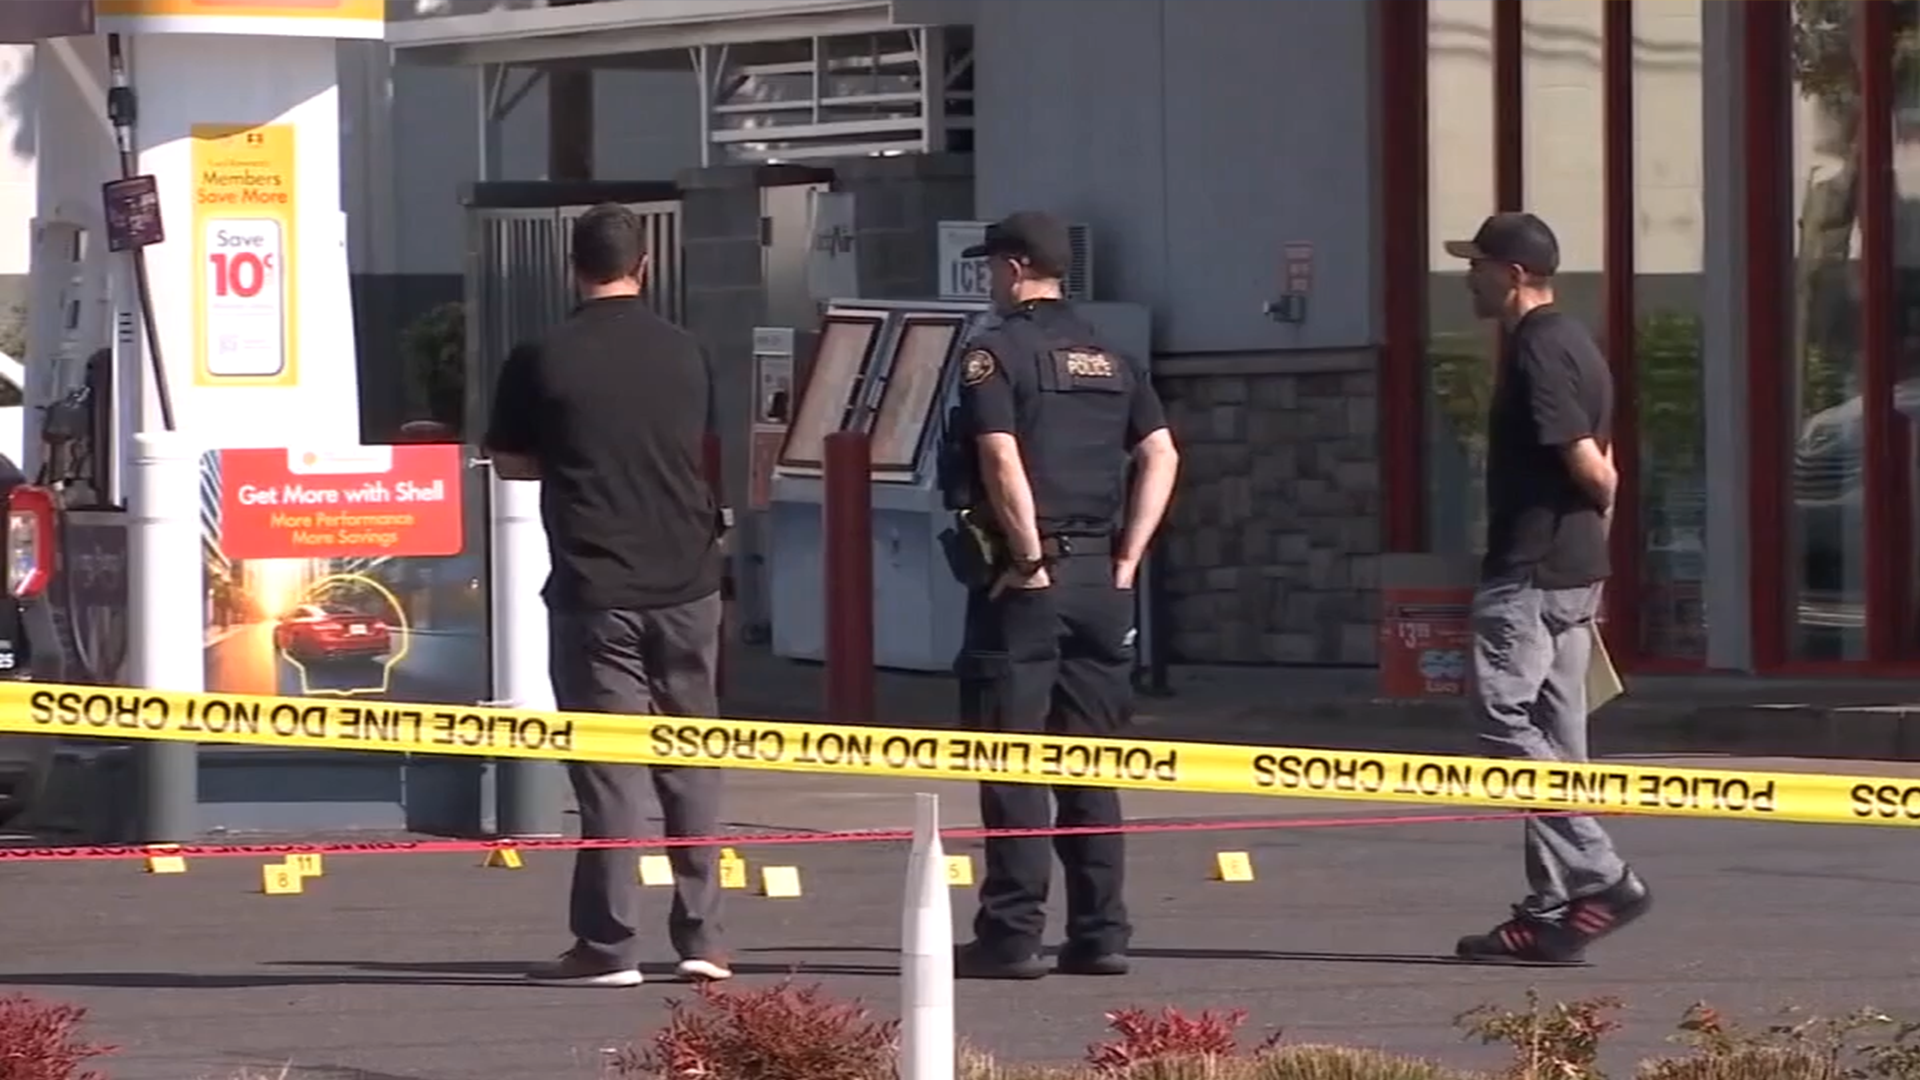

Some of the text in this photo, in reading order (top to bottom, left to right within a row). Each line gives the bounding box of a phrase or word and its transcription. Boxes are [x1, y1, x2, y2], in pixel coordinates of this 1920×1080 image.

[203, 170, 282, 187] Members
[197, 188, 288, 204] Save More
[217, 230, 264, 247] Save
[951, 260, 988, 294] ICE
[238, 479, 444, 504] Get More with Shell
[271, 510, 414, 528] More Performance
[292, 528, 398, 547] More Savings
[30, 691, 573, 751] POLICE LINE DO NOT CROSS
[650, 723, 1178, 781] POLICE LINE DO NOT CROSS
[1252, 754, 1775, 812] POLICE LINE DO NOT CROSS
[297, 856, 312, 871] 11
[949, 863, 960, 879] 5
[277, 871, 289, 888] 8
